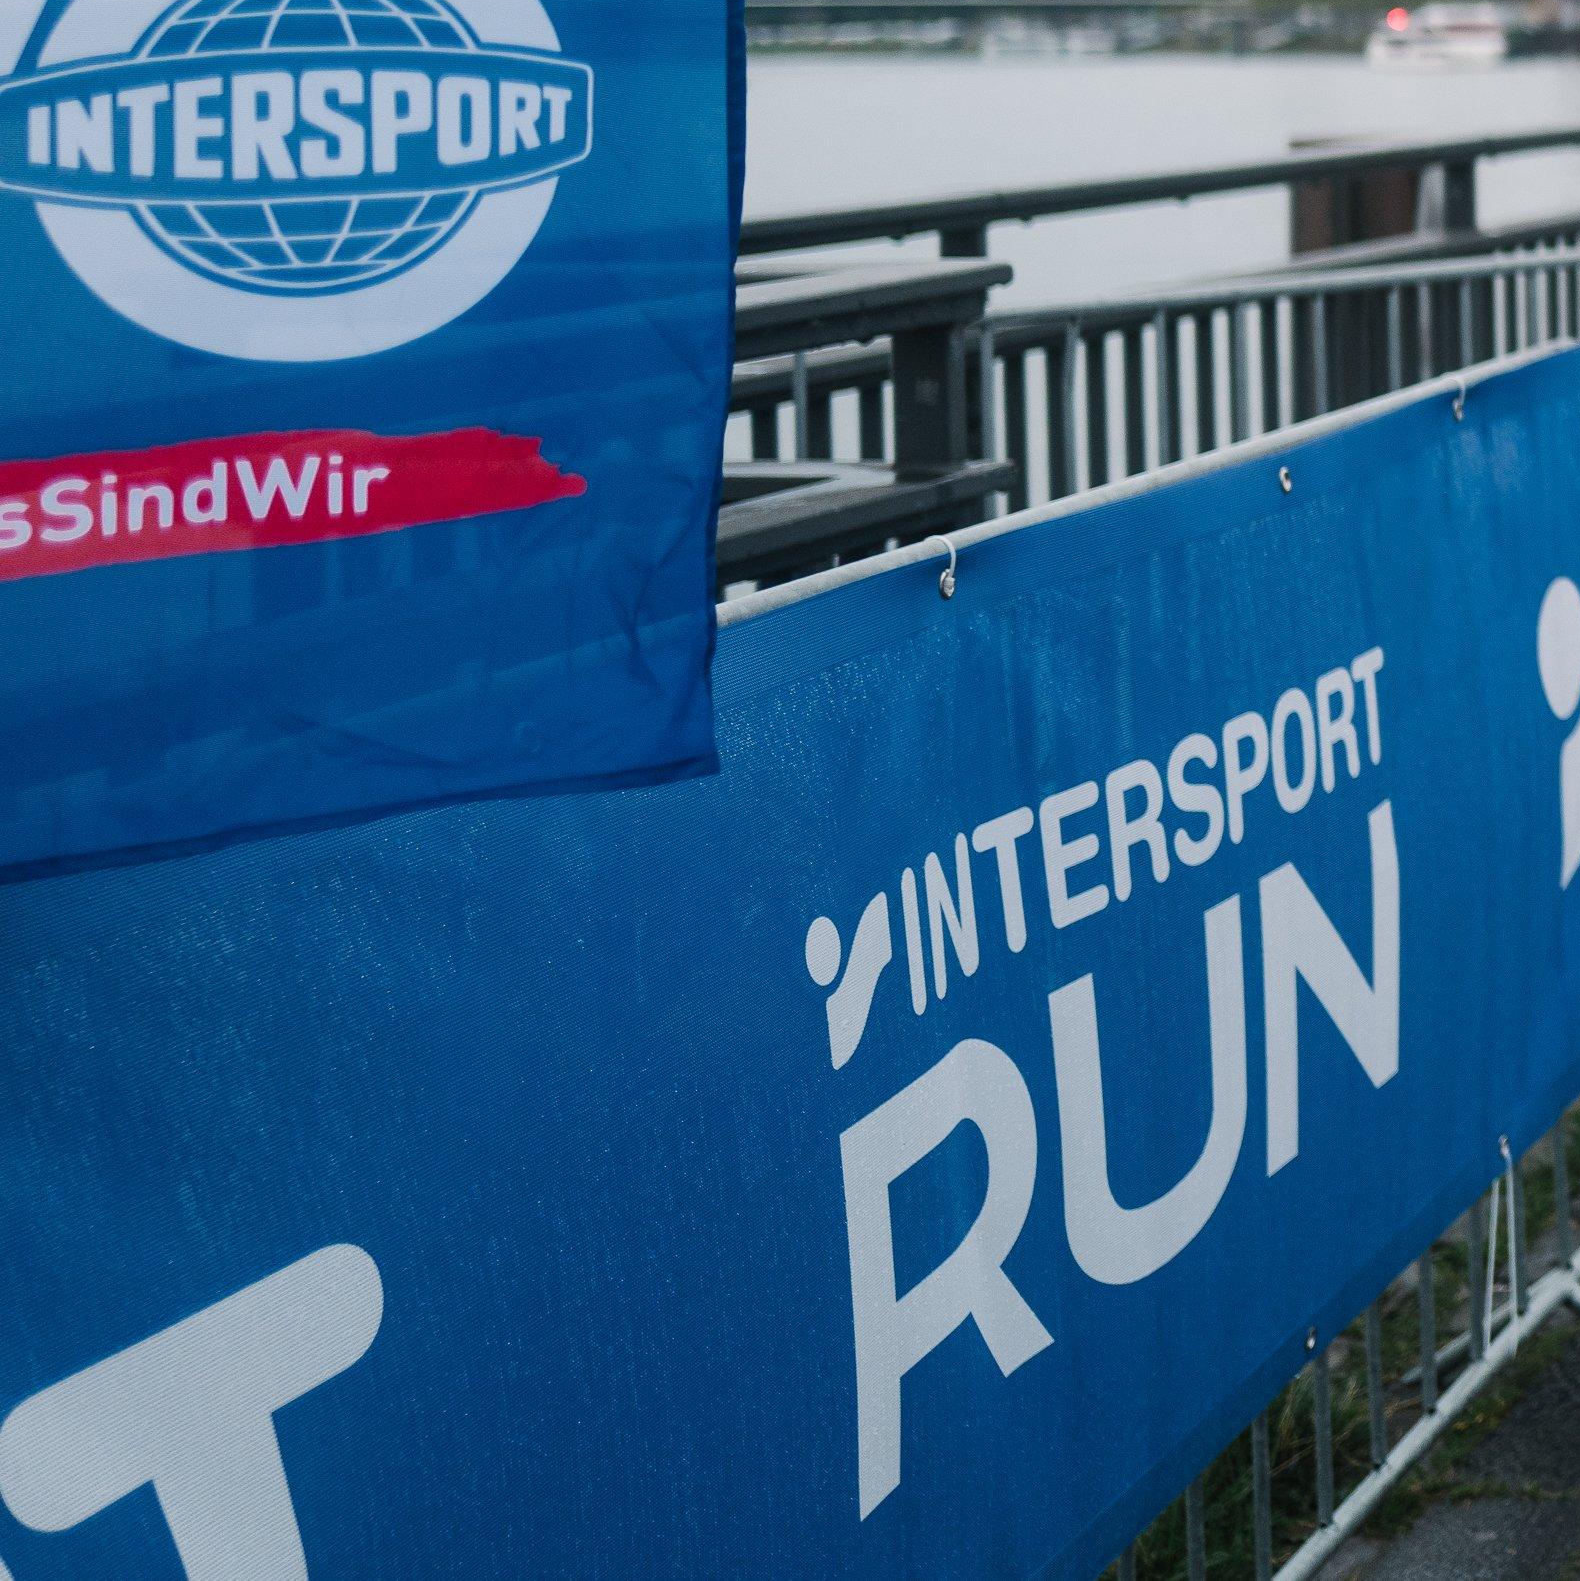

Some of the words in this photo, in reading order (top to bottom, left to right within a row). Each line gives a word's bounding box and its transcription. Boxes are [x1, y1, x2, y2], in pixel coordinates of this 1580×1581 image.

[27, 69, 573, 181] INTERSPORT
[901, 645, 1384, 1016] INTERSPORT
[840, 798, 1400, 1522] RUN
